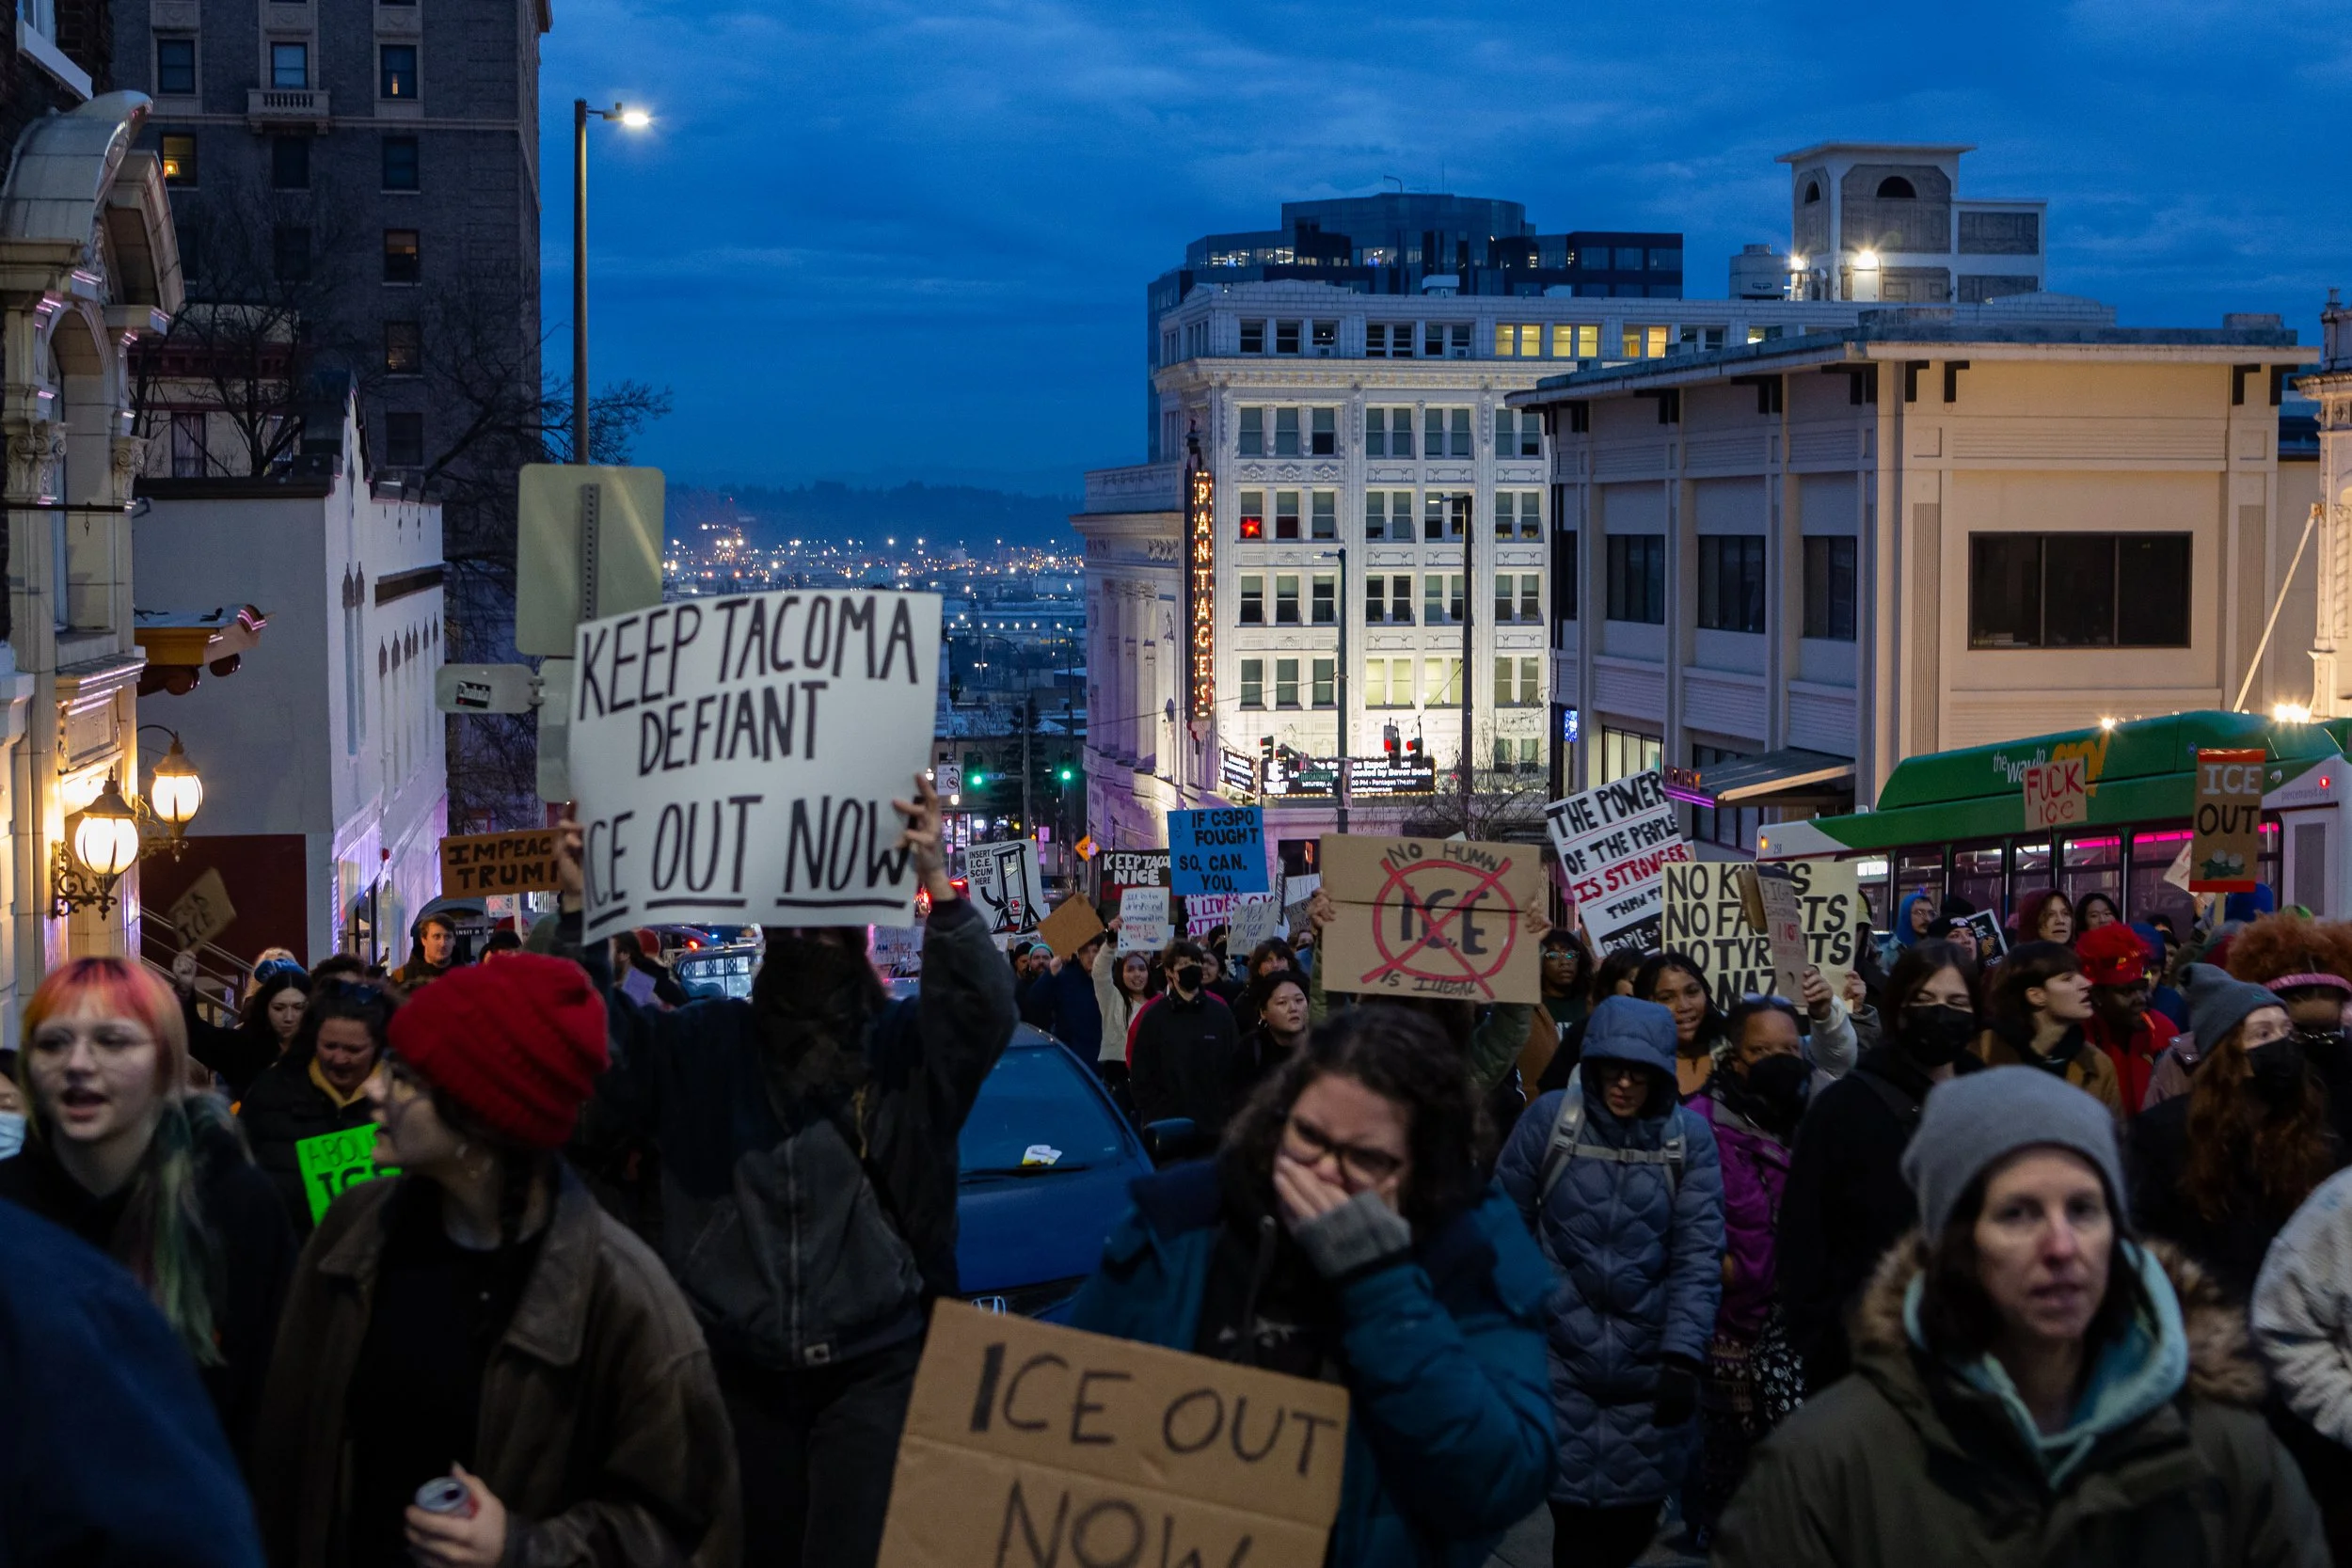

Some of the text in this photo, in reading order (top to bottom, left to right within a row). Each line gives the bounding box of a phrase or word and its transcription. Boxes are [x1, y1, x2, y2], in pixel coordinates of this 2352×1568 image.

[1197, 481, 1210, 705] PANTAGES
[578, 595, 918, 721] KEEP TACOMA
[639, 680, 829, 777] DEFIANT
[1300, 773, 1332, 782] BROADWAY
[1993, 747, 2046, 784] the wa to
[2201, 765, 2263, 796] ICE
[2026, 762, 2085, 806] FUCK
[2280, 787, 2330, 803] piercetransit.org
[1546, 798, 1598, 838] THE
[1595, 770, 1669, 825] POWER
[2197, 803, 2260, 836] OUT
[1191, 812, 1205, 829] IF
[448, 836, 552, 865] IMPEAC
[652, 794, 763, 895] OUT
[783, 794, 920, 894] NOW
[1194, 828, 1260, 847] FOUGHT
[969, 849, 991, 860] INSERT
[1104, 853, 1171, 871] KEEP TACO
[1208, 853, 1248, 871] CAN.
[1386, 843, 1502, 872] NO HUMAN
[1564, 848, 1588, 876] OF
[1588, 831, 1631, 863] THE
[970, 867, 993, 878] SCUM
[975, 877, 992, 886] HERE
[1114, 869, 1161, 885] NICE
[1200, 874, 1239, 893] YOU.
[1573, 876, 1604, 904] IS
[1604, 843, 1690, 892] STRONGER
[1666, 864, 1709, 902] NO
[1605, 892, 1648, 920] THAN
[1666, 900, 1710, 941] NO
[1716, 894, 1849, 937] FATS
[1188, 915, 1232, 935] ATTE
[1713, 931, 1852, 971] TYRTS
[1379, 969, 1402, 988] IS
[307, 1131, 378, 1171] ABOL
[969, 1342, 1339, 1478] ICE OUT
[995, 1480, 1253, 1568] NOW
